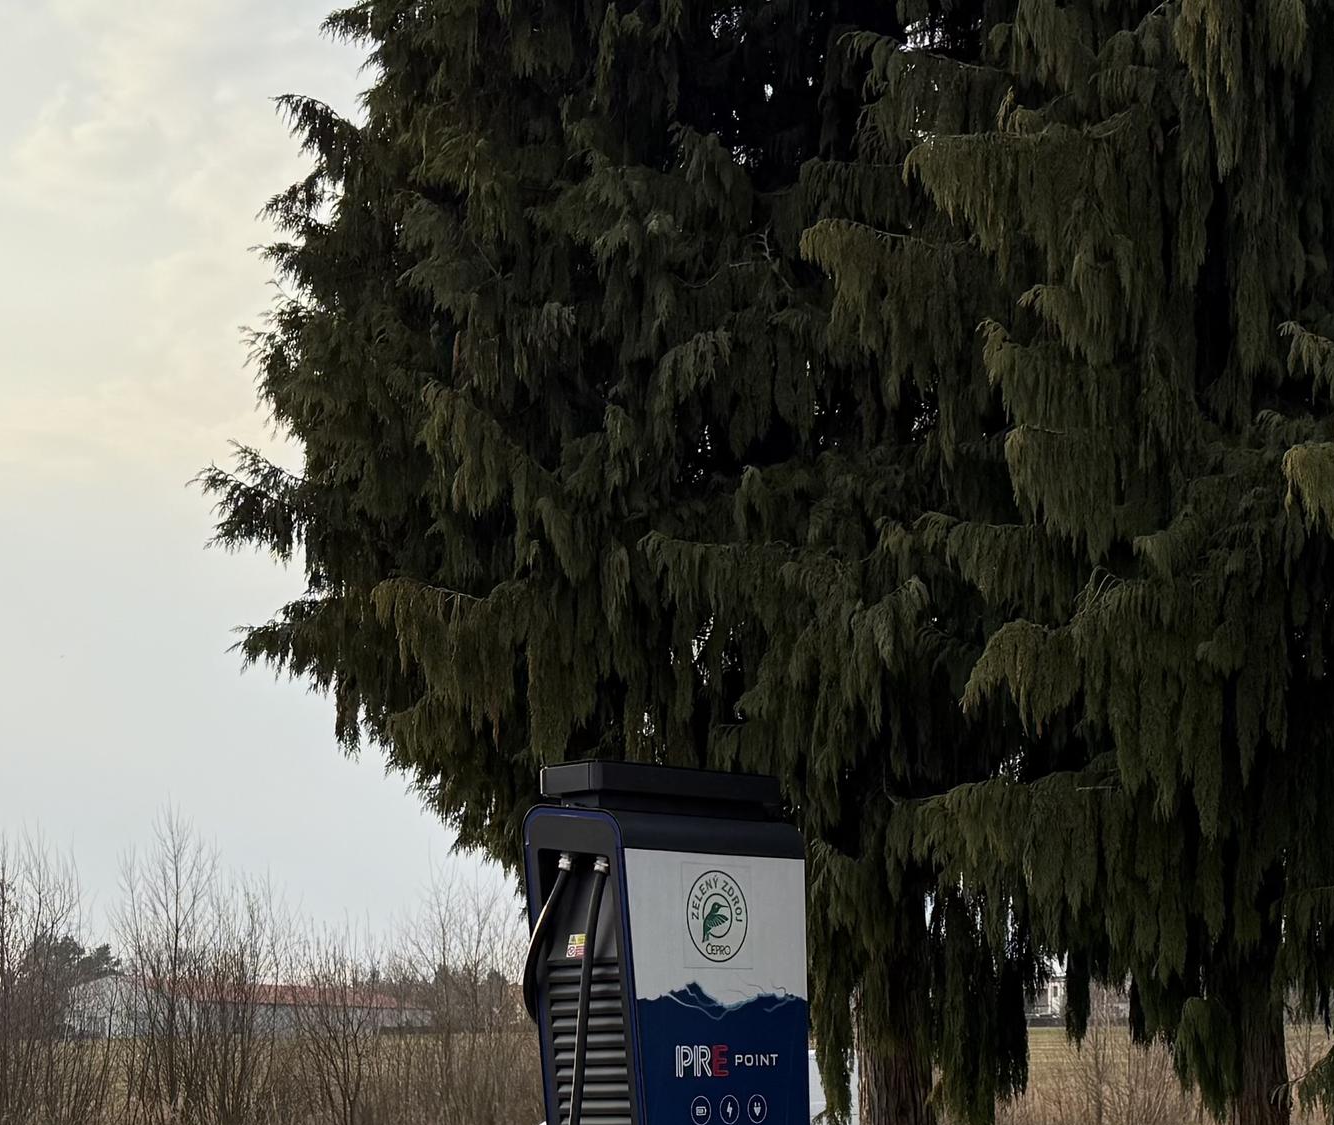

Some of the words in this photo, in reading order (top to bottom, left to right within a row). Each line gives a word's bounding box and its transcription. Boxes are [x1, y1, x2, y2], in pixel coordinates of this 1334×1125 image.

[691, 874, 719, 920] ZELENÝ
[721, 880, 743, 922] ZDROJ
[675, 1045, 729, 1078] PRE
[734, 1054, 779, 1067] POINT
